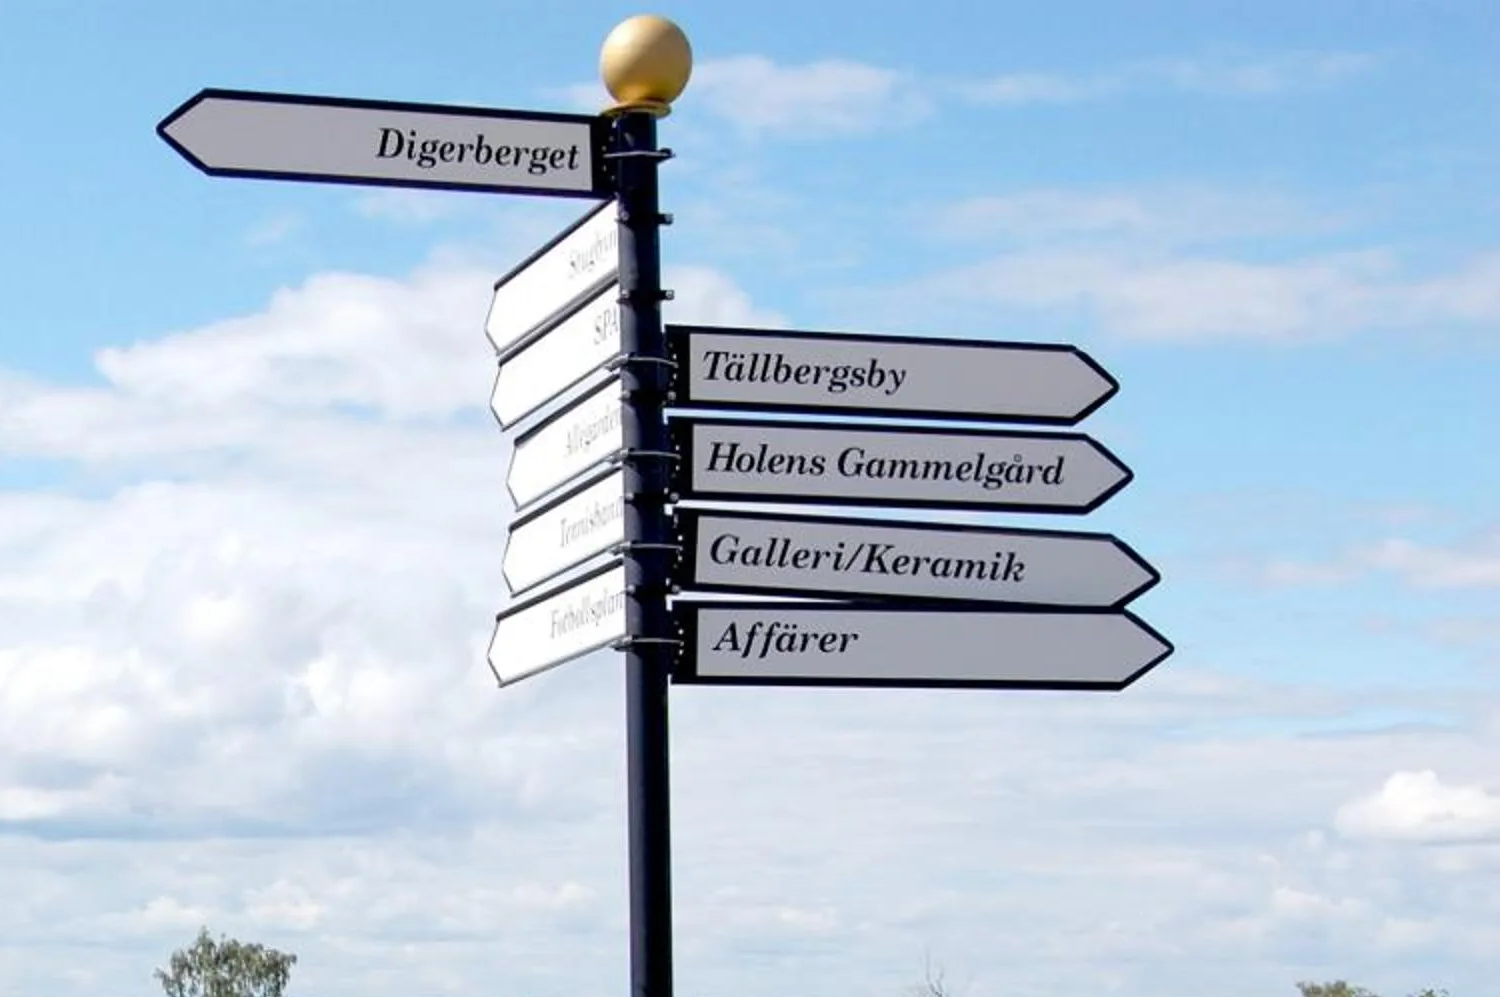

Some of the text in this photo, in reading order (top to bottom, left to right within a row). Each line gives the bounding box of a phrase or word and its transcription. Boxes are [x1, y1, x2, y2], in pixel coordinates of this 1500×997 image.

[376, 127, 581, 175] Digerberget
[593, 307, 619, 345] SPA
[703, 350, 907, 396] Tällbergsby
[705, 441, 1065, 490] Holens Gammelgård
[708, 533, 1026, 583] Galleri/Keramik
[711, 621, 859, 659] Affärer
